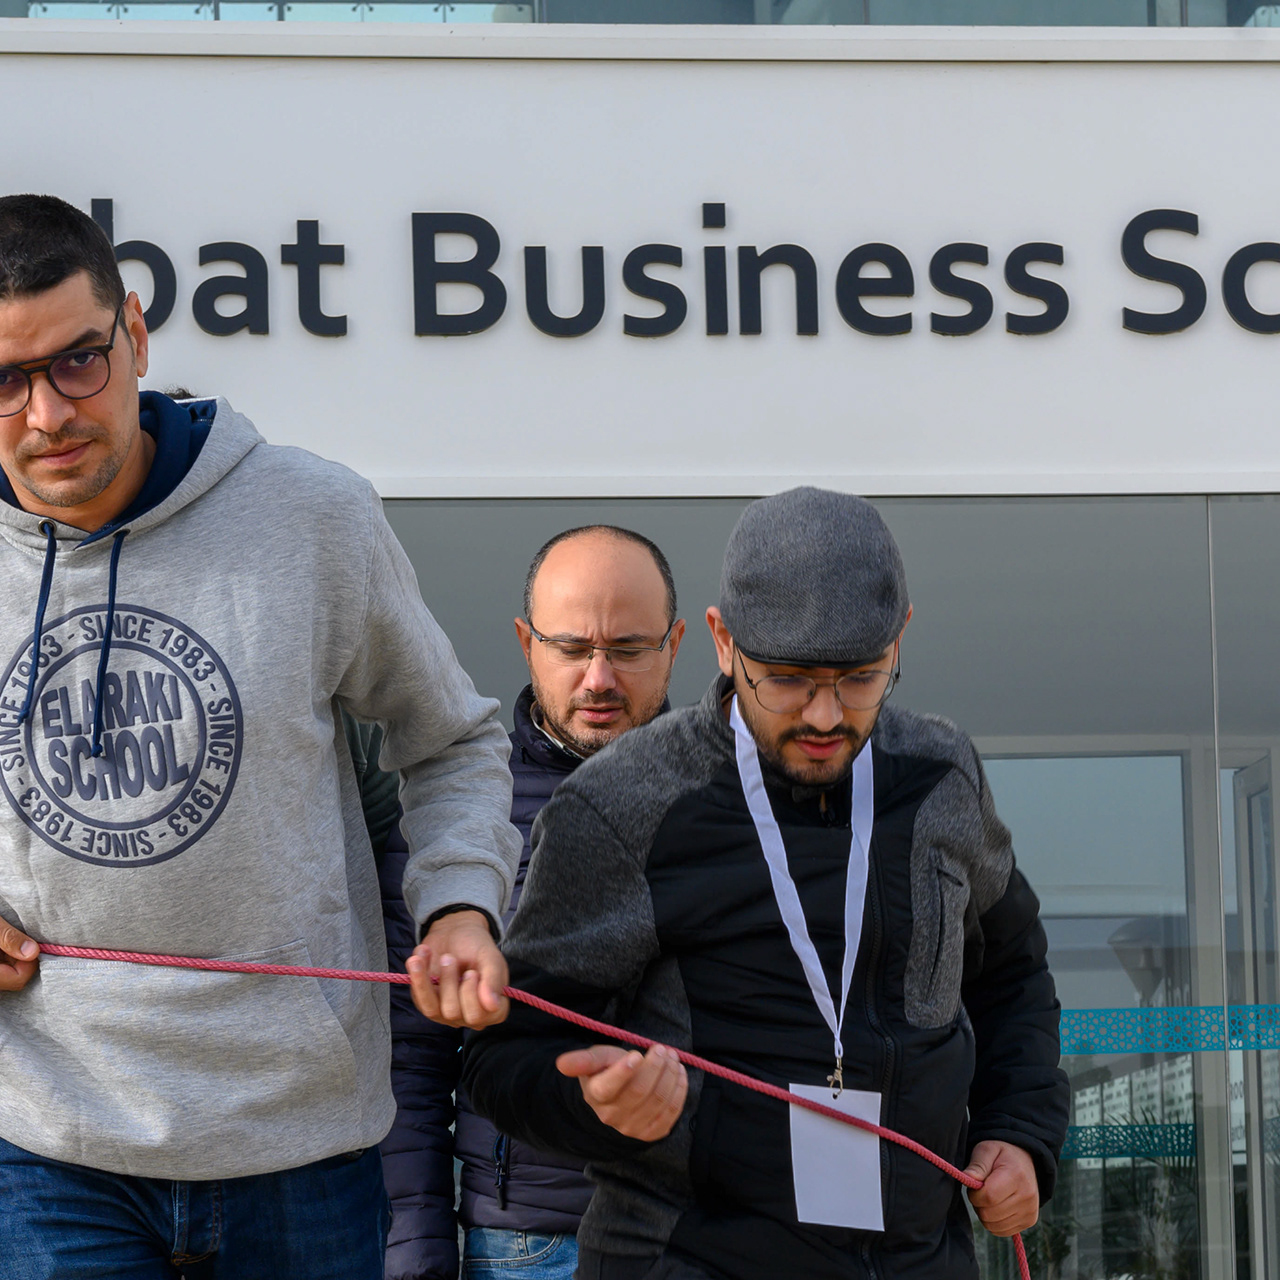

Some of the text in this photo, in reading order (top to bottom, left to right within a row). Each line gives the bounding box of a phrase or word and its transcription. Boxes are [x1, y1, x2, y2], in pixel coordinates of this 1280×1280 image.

[411, 203, 1069, 338] Business
[78, 613, 216, 681] SINCE 1983
[40, 670, 183, 739] ELARAKI
[47, 723, 190, 801] SCHOOL
[166, 696, 236, 838] SINCE 1983
[20, 786, 155, 858] SINCE 1983
